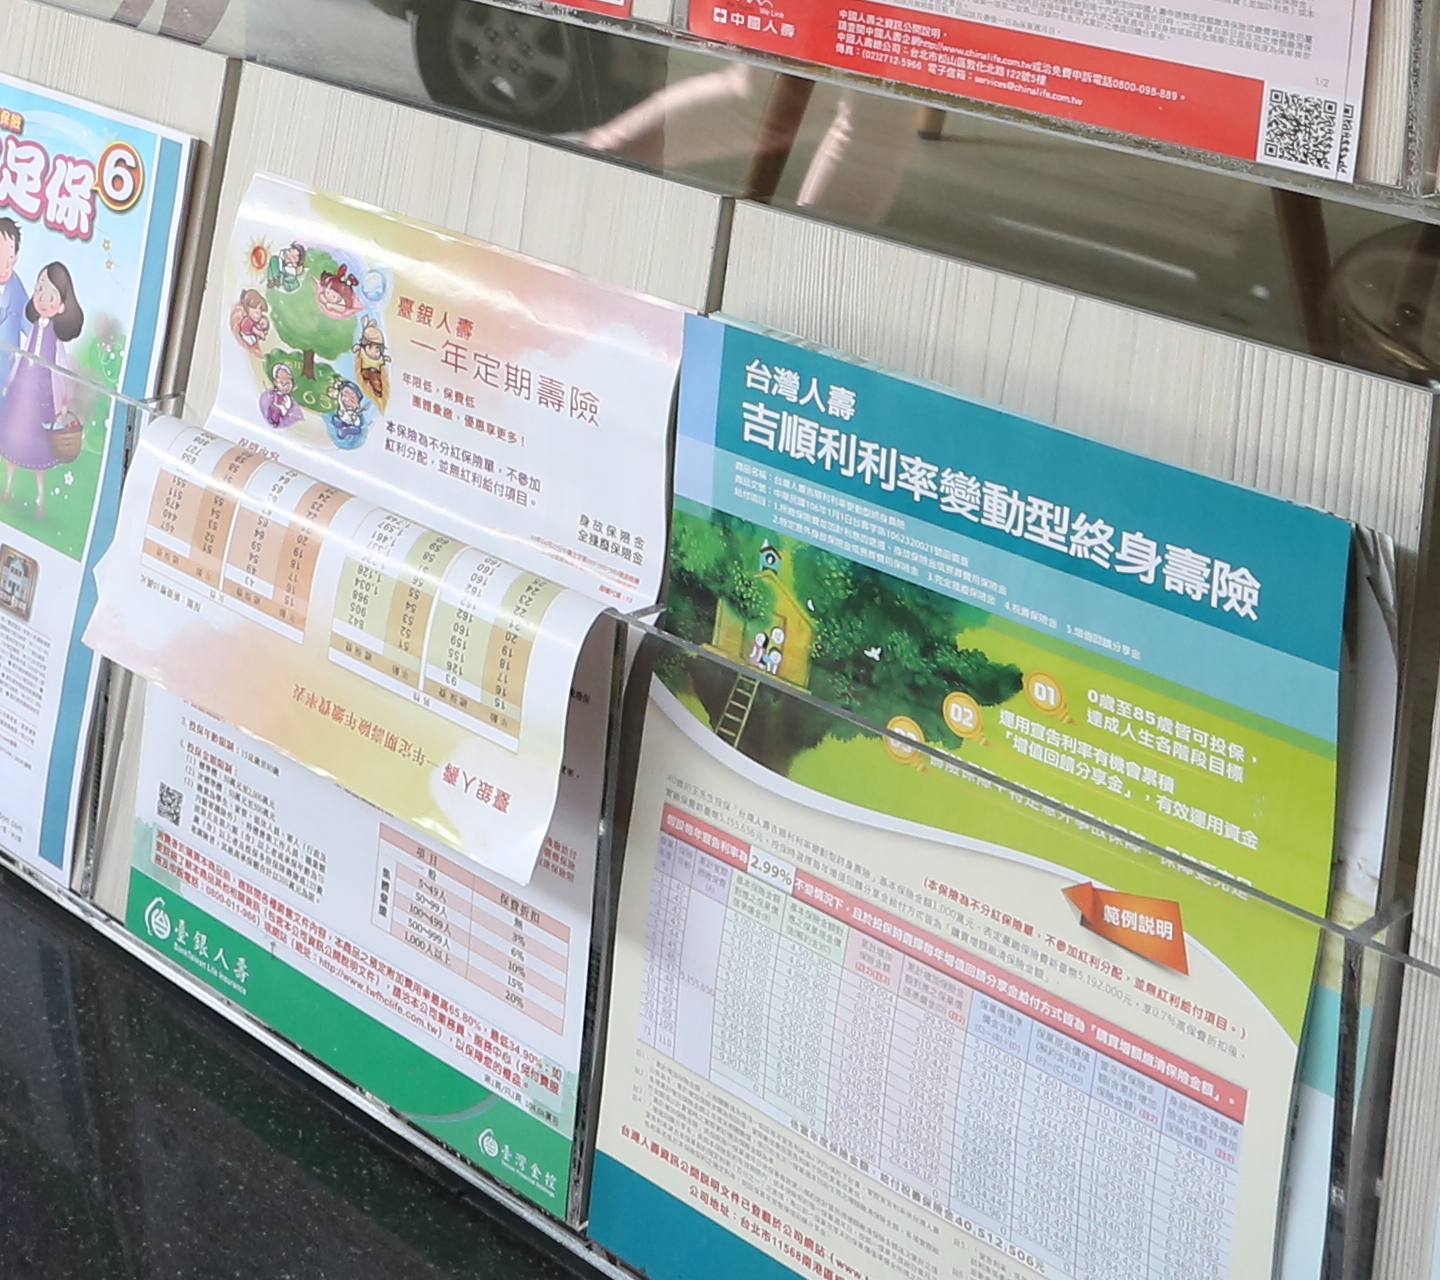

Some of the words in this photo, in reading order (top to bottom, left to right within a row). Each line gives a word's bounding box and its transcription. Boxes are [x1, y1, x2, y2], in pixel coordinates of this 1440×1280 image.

[731, 11, 795, 38] 中國人壽
[102, 150, 135, 200] 6
[397, 297, 474, 341] 臺銀人壽
[410, 336, 601, 428] 一年定期壽險
[745, 359, 856, 422] 台灣人壽
[386, 420, 541, 493] 本保險為不分紅保險單，不參加
[579, 514, 645, 551] 身故保險金
[741, 401, 1262, 622] 吉順利利率變動型終身壽險
[578, 529, 644, 567] 全殘廢保險金
[949, 703, 974, 728] 02
[1033, 680, 1057, 706] 01
[999, 709, 1176, 794] 運用宣告利率有機會累積
[1087, 707, 1244, 784] 達成人生各階段目標
[1088, 689, 1258, 764] 0歲至85歲皆可投保，
[750, 852, 795, 886] 2.99%
[1103, 904, 1174, 941] 範例說明
[174, 916, 251, 984] 臺銀人壽
